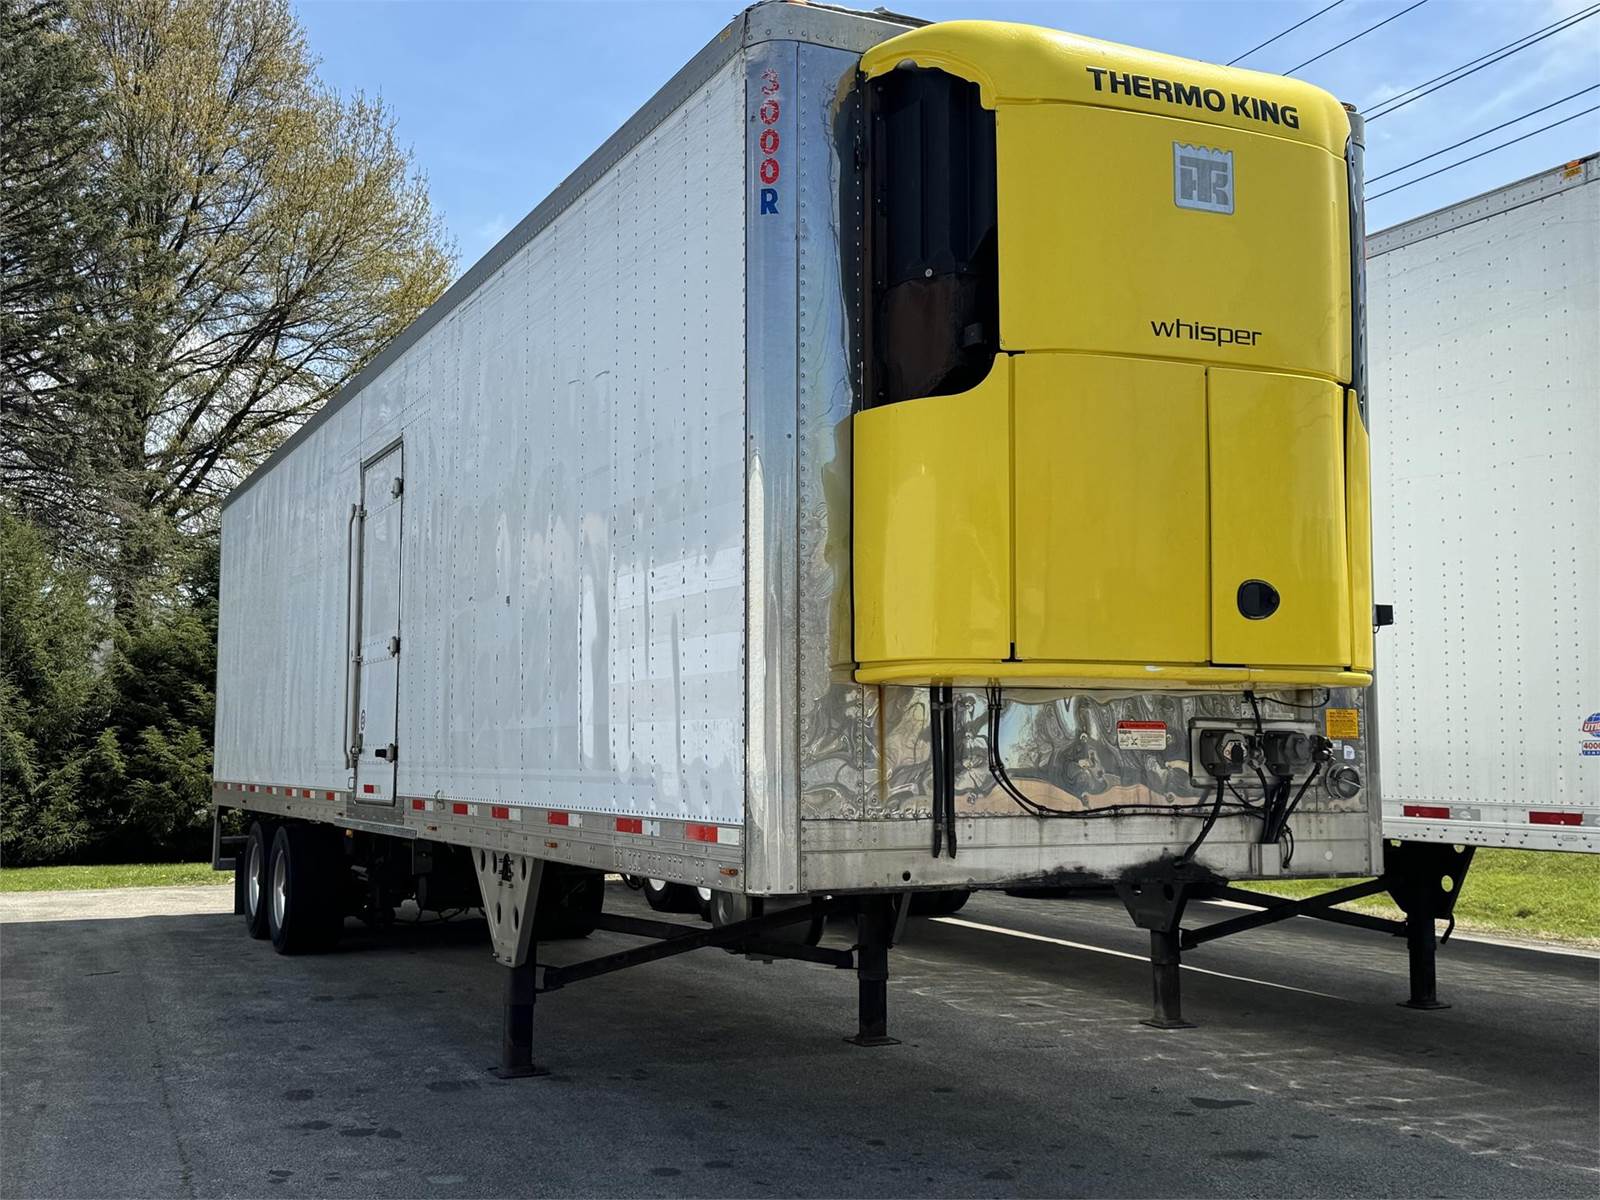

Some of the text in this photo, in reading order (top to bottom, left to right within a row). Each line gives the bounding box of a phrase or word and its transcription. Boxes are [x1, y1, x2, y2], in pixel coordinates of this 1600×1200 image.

[1086, 66, 1300, 129] THERMO KING
[760, 68, 780, 215] 3000R
[1151, 318, 1262, 347] whisper
